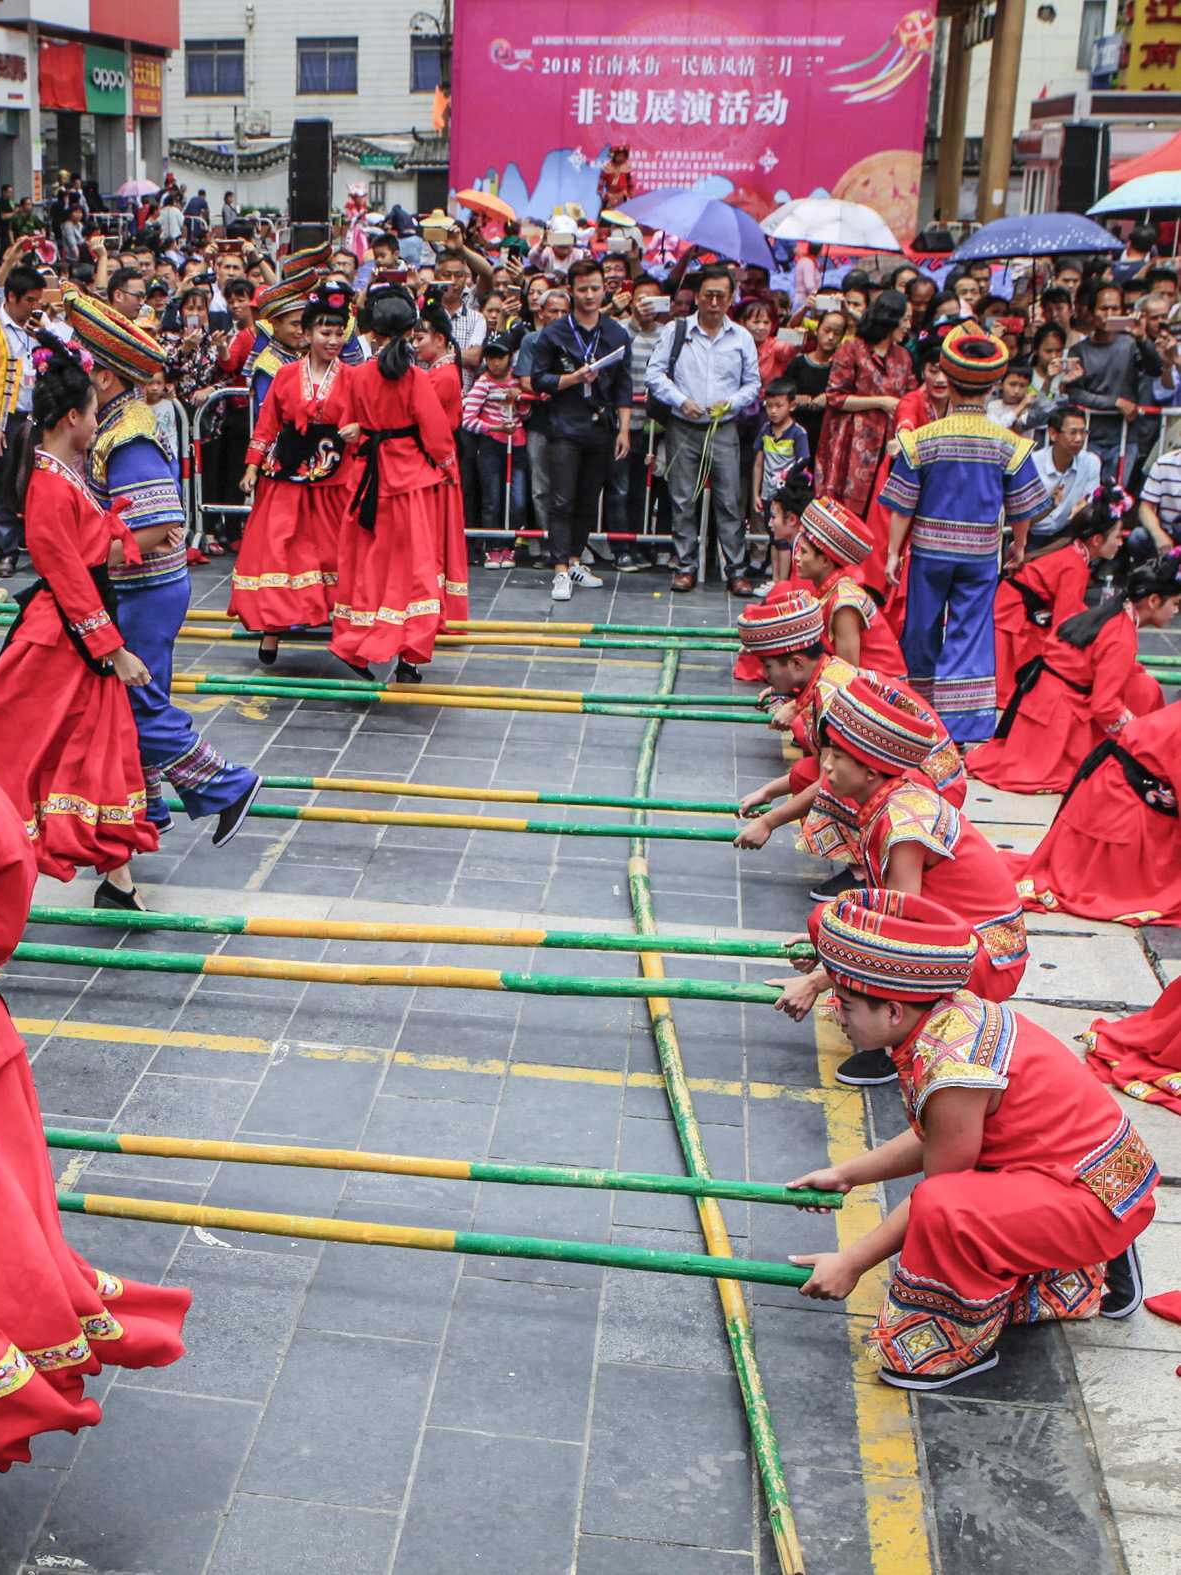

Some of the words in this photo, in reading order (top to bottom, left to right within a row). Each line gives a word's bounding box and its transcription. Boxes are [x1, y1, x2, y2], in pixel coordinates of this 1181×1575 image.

[1140, 0, 1181, 91] 江南
[541, 56, 581, 74] 2018
[570, 88, 788, 125] 非遗展演活动
